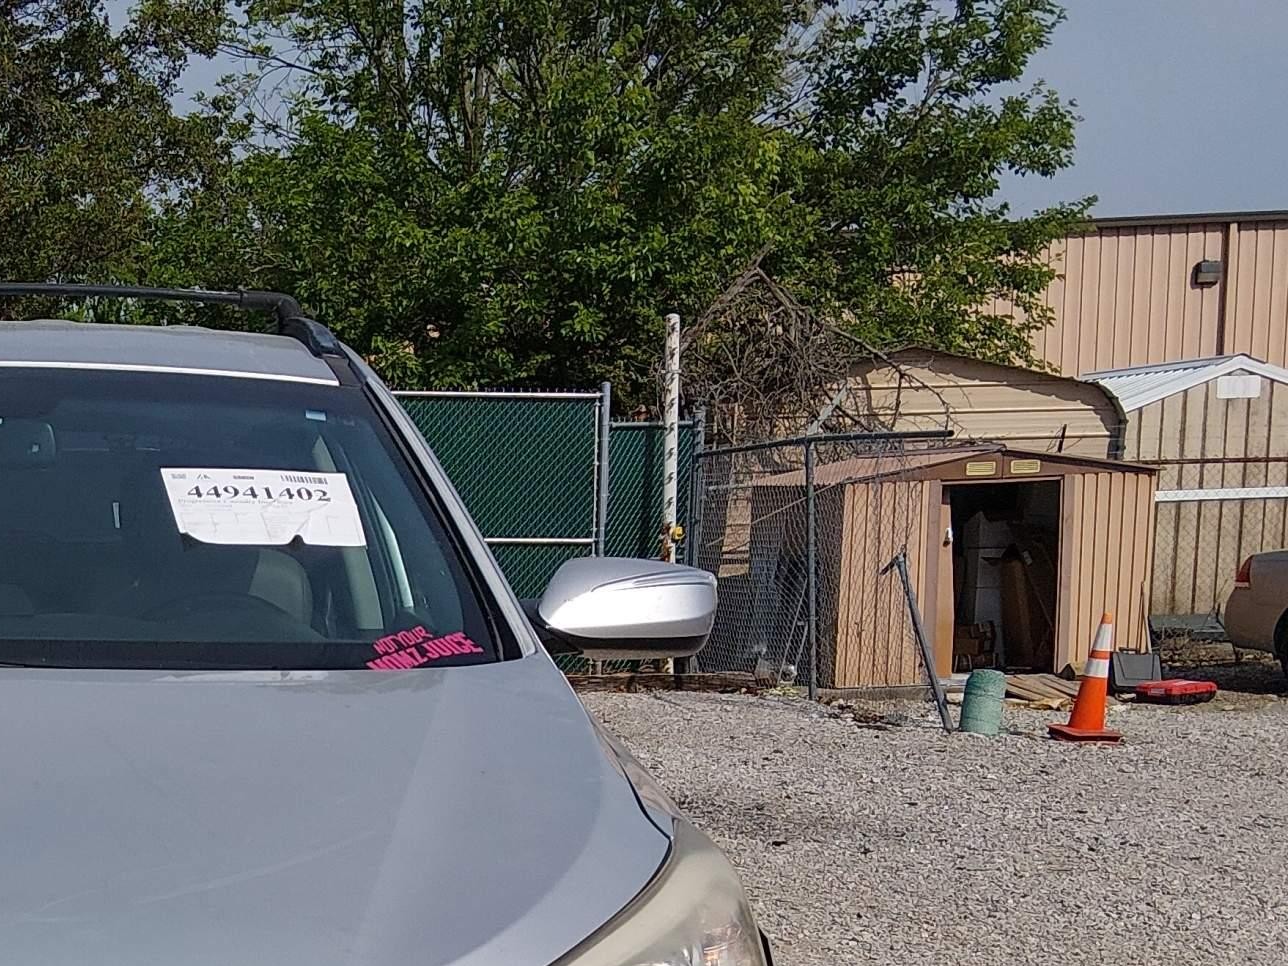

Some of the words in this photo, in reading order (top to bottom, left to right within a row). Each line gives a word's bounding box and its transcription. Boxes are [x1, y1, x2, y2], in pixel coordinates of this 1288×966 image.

[187, 485, 331, 503] 44941402
[397, 625, 433, 647] YOUR
[422, 631, 484, 659] JUICE
